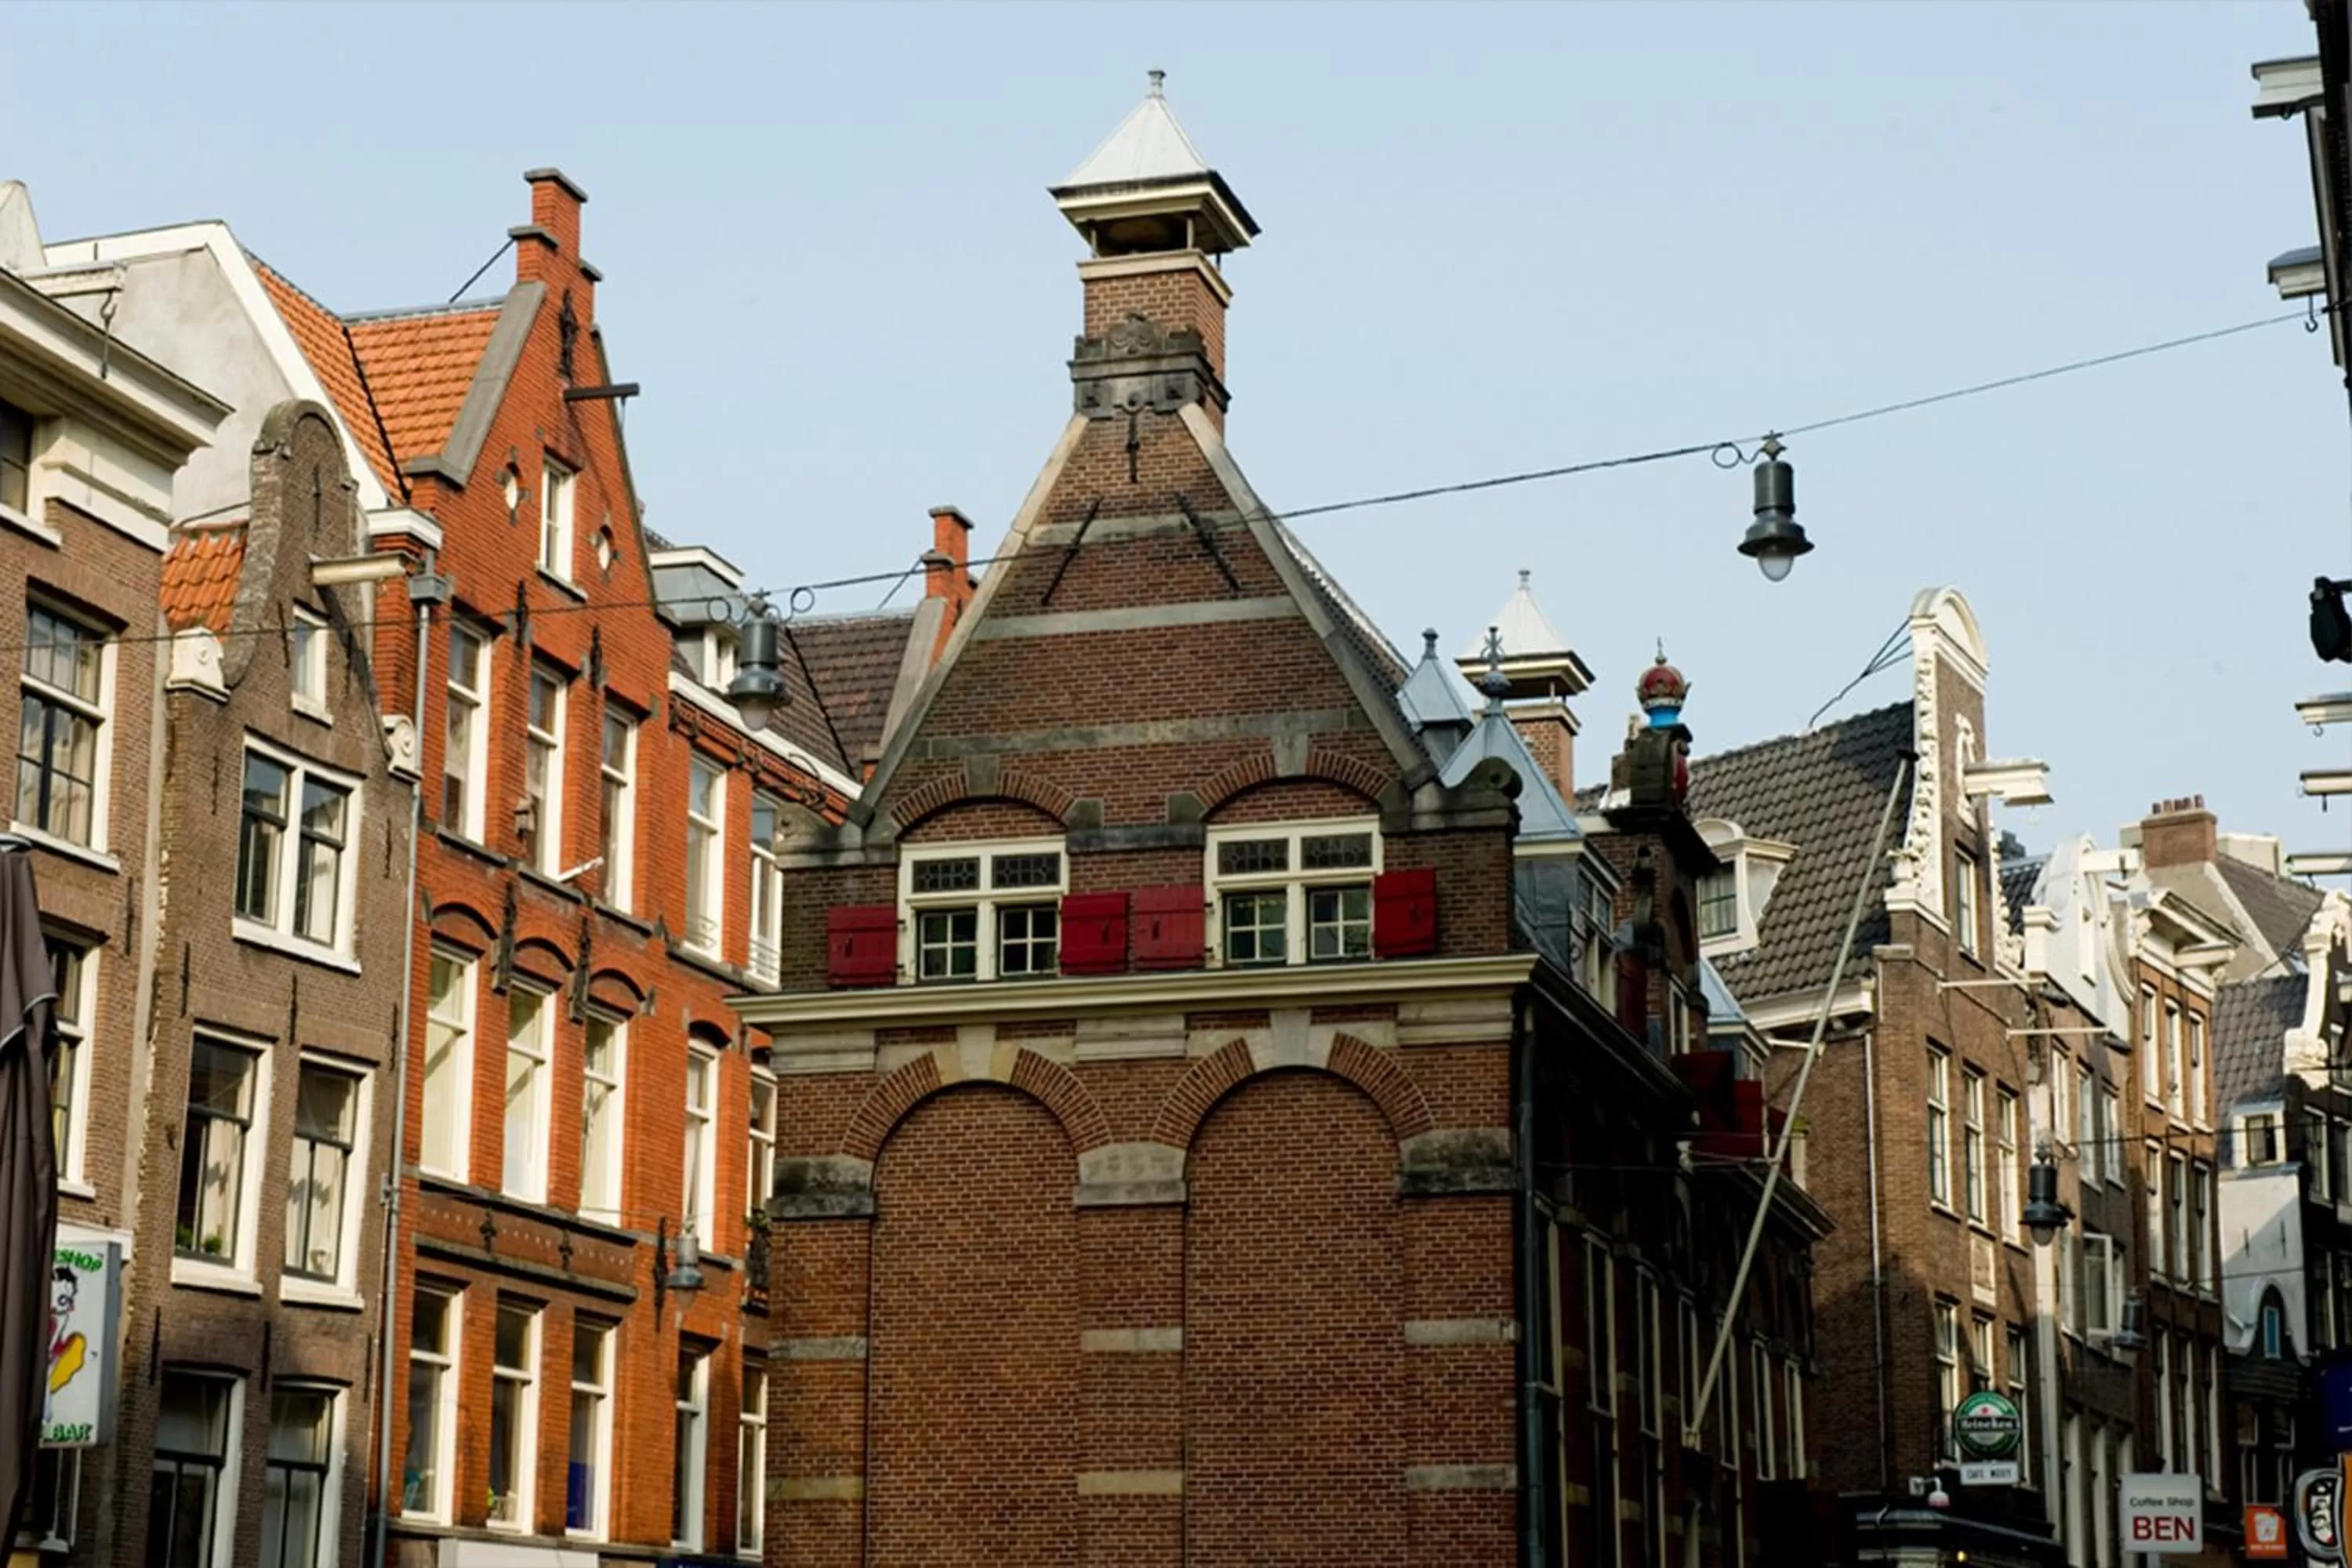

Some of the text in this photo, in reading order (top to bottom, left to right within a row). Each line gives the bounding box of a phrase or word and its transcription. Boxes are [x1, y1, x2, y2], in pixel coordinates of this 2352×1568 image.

[1962, 1417, 2013, 1428] Heineken
[2129, 1497, 2194, 1508] Coffee Shop
[2133, 1515, 2194, 1541] BEN
